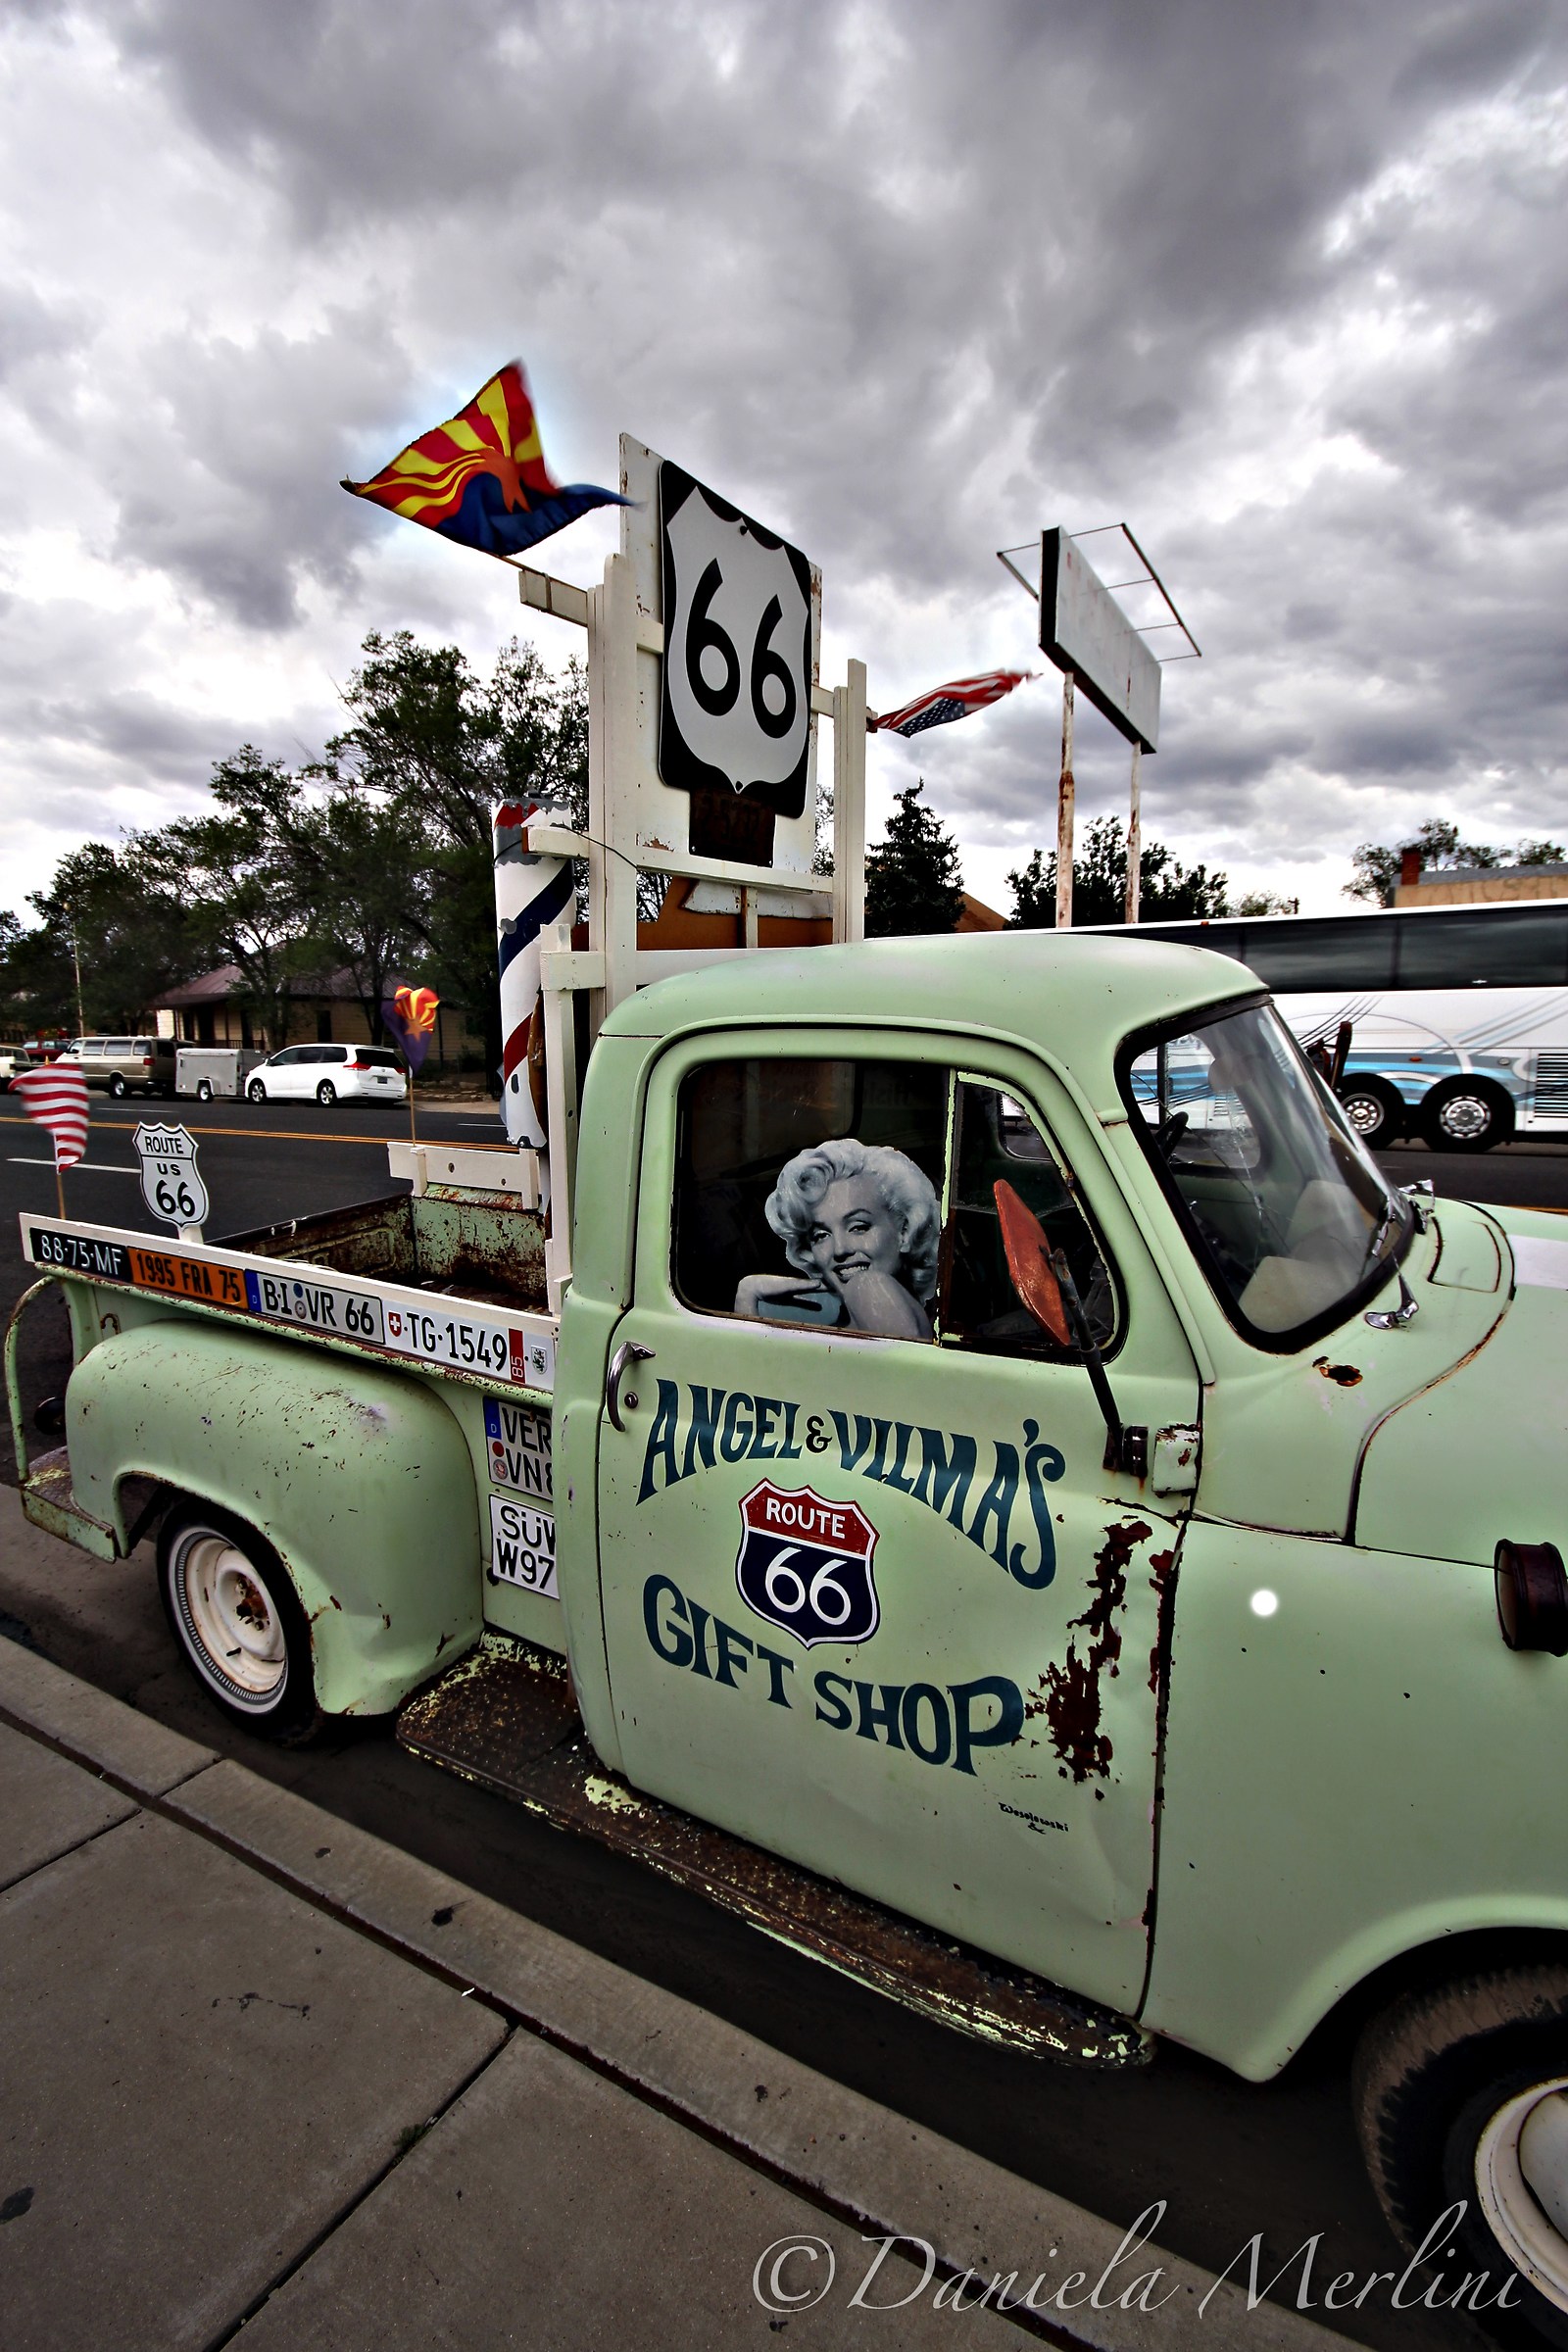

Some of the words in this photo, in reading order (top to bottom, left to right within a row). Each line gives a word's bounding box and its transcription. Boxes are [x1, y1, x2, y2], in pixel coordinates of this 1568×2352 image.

[685, 557, 796, 739] 66
[144, 1136, 184, 1153] ROUTE
[157, 1162, 181, 1176] US
[155, 1179, 196, 1217] 66
[136, 1252, 175, 1287] 1995
[180, 1262, 213, 1296] FRA
[635, 1378, 802, 1506] ANGEL
[826, 1409, 1066, 1590] VILMA'S
[765, 1496, 846, 1540] ROUTE
[496, 1538, 555, 1590] W97
[764, 1546, 852, 1626] 66
[642, 1574, 795, 1709] GIFT
[813, 1670, 1027, 1778] SHOP
